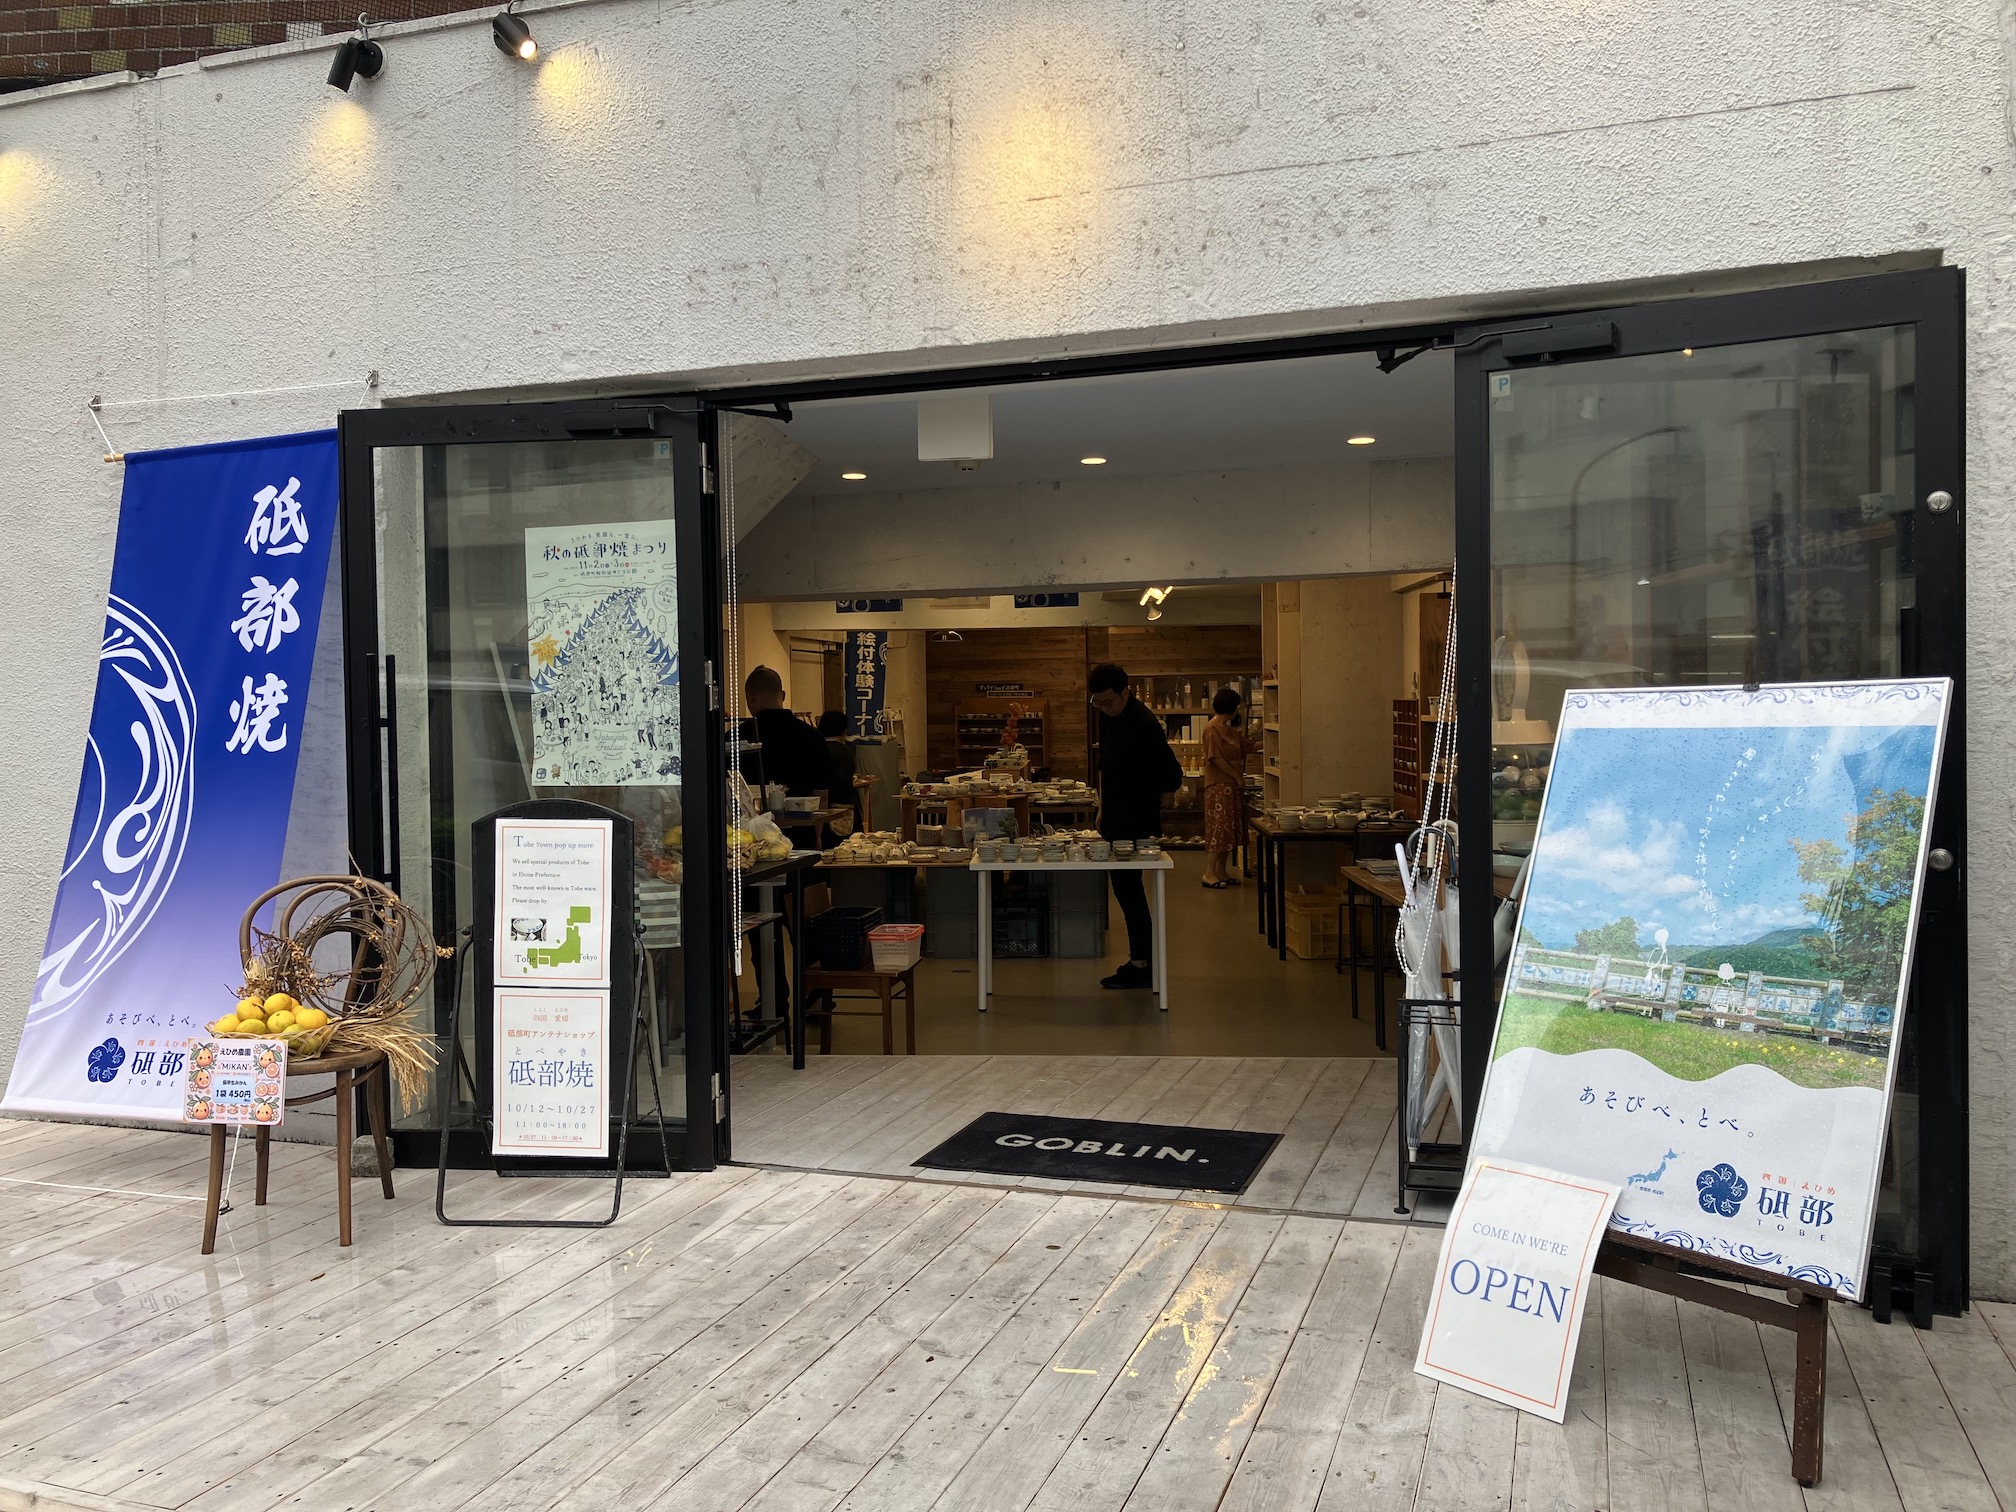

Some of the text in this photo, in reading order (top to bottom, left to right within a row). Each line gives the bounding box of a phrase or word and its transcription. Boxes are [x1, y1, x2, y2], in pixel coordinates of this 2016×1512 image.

[543, 541, 667, 561] 秋の砥部焼まつり
[225, 476, 309, 755] 砥部焼
[854, 632, 876, 737] 絵付体験コーナー
[514, 953, 598, 963] Tobe Tokyo
[106, 1013, 197, 1029] あそびべ、とべ。
[507, 1029, 596, 1039] 砥部町アンテナショップ
[130, 1050, 186, 1077] 砥部
[515, 1046, 588, 1057] とべやき
[127, 1078, 176, 1087] TOBE
[508, 1059, 594, 1089] 砥部焼
[228, 1090, 251, 1099] 450円
[1579, 1085, 1754, 1139] あそびべ、とべ。
[994, 1133, 1210, 1164] GOBLIN.
[1756, 1186, 1835, 1227] 砥部
[1472, 1222, 1569, 1256] COME IN WE'RE
[1757, 1218, 1827, 1242] TOBE
[1450, 1259, 1571, 1323] OPEN
